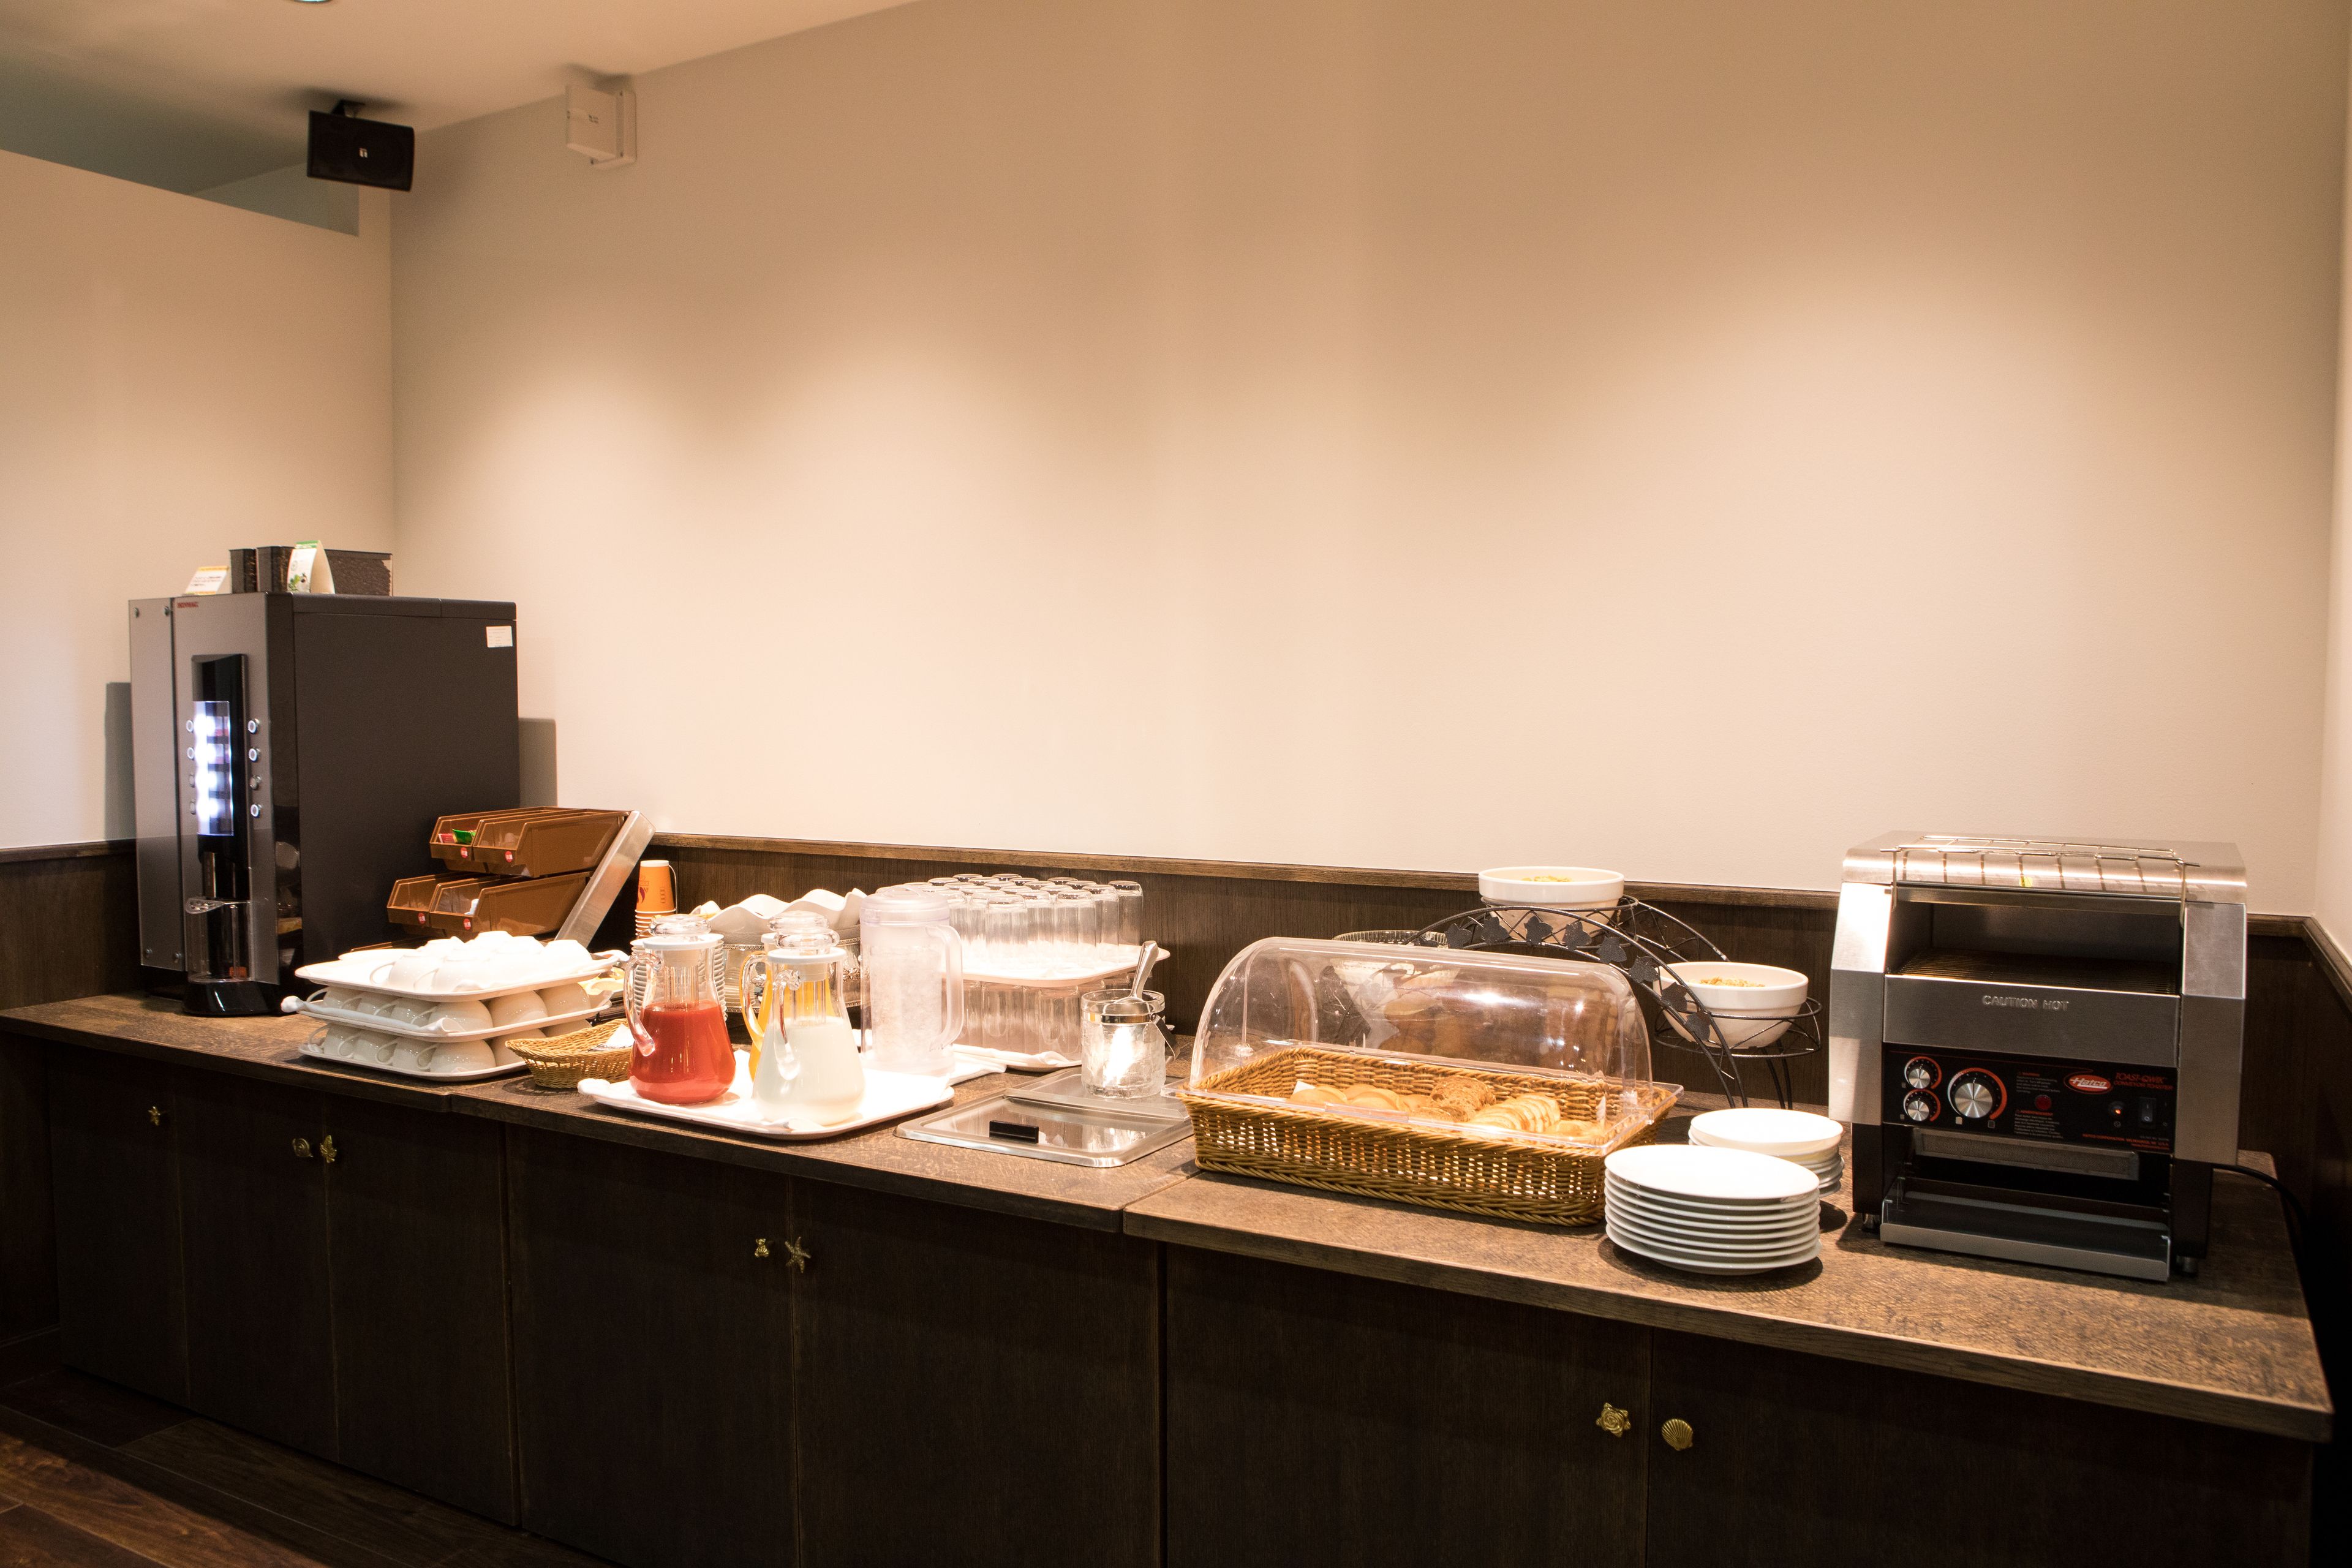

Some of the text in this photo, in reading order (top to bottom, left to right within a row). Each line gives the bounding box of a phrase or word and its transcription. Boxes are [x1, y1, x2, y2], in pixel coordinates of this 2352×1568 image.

[1982, 995, 2069, 1011] CAUTION HOT
[2070, 1077, 2108, 1088] Hatco
